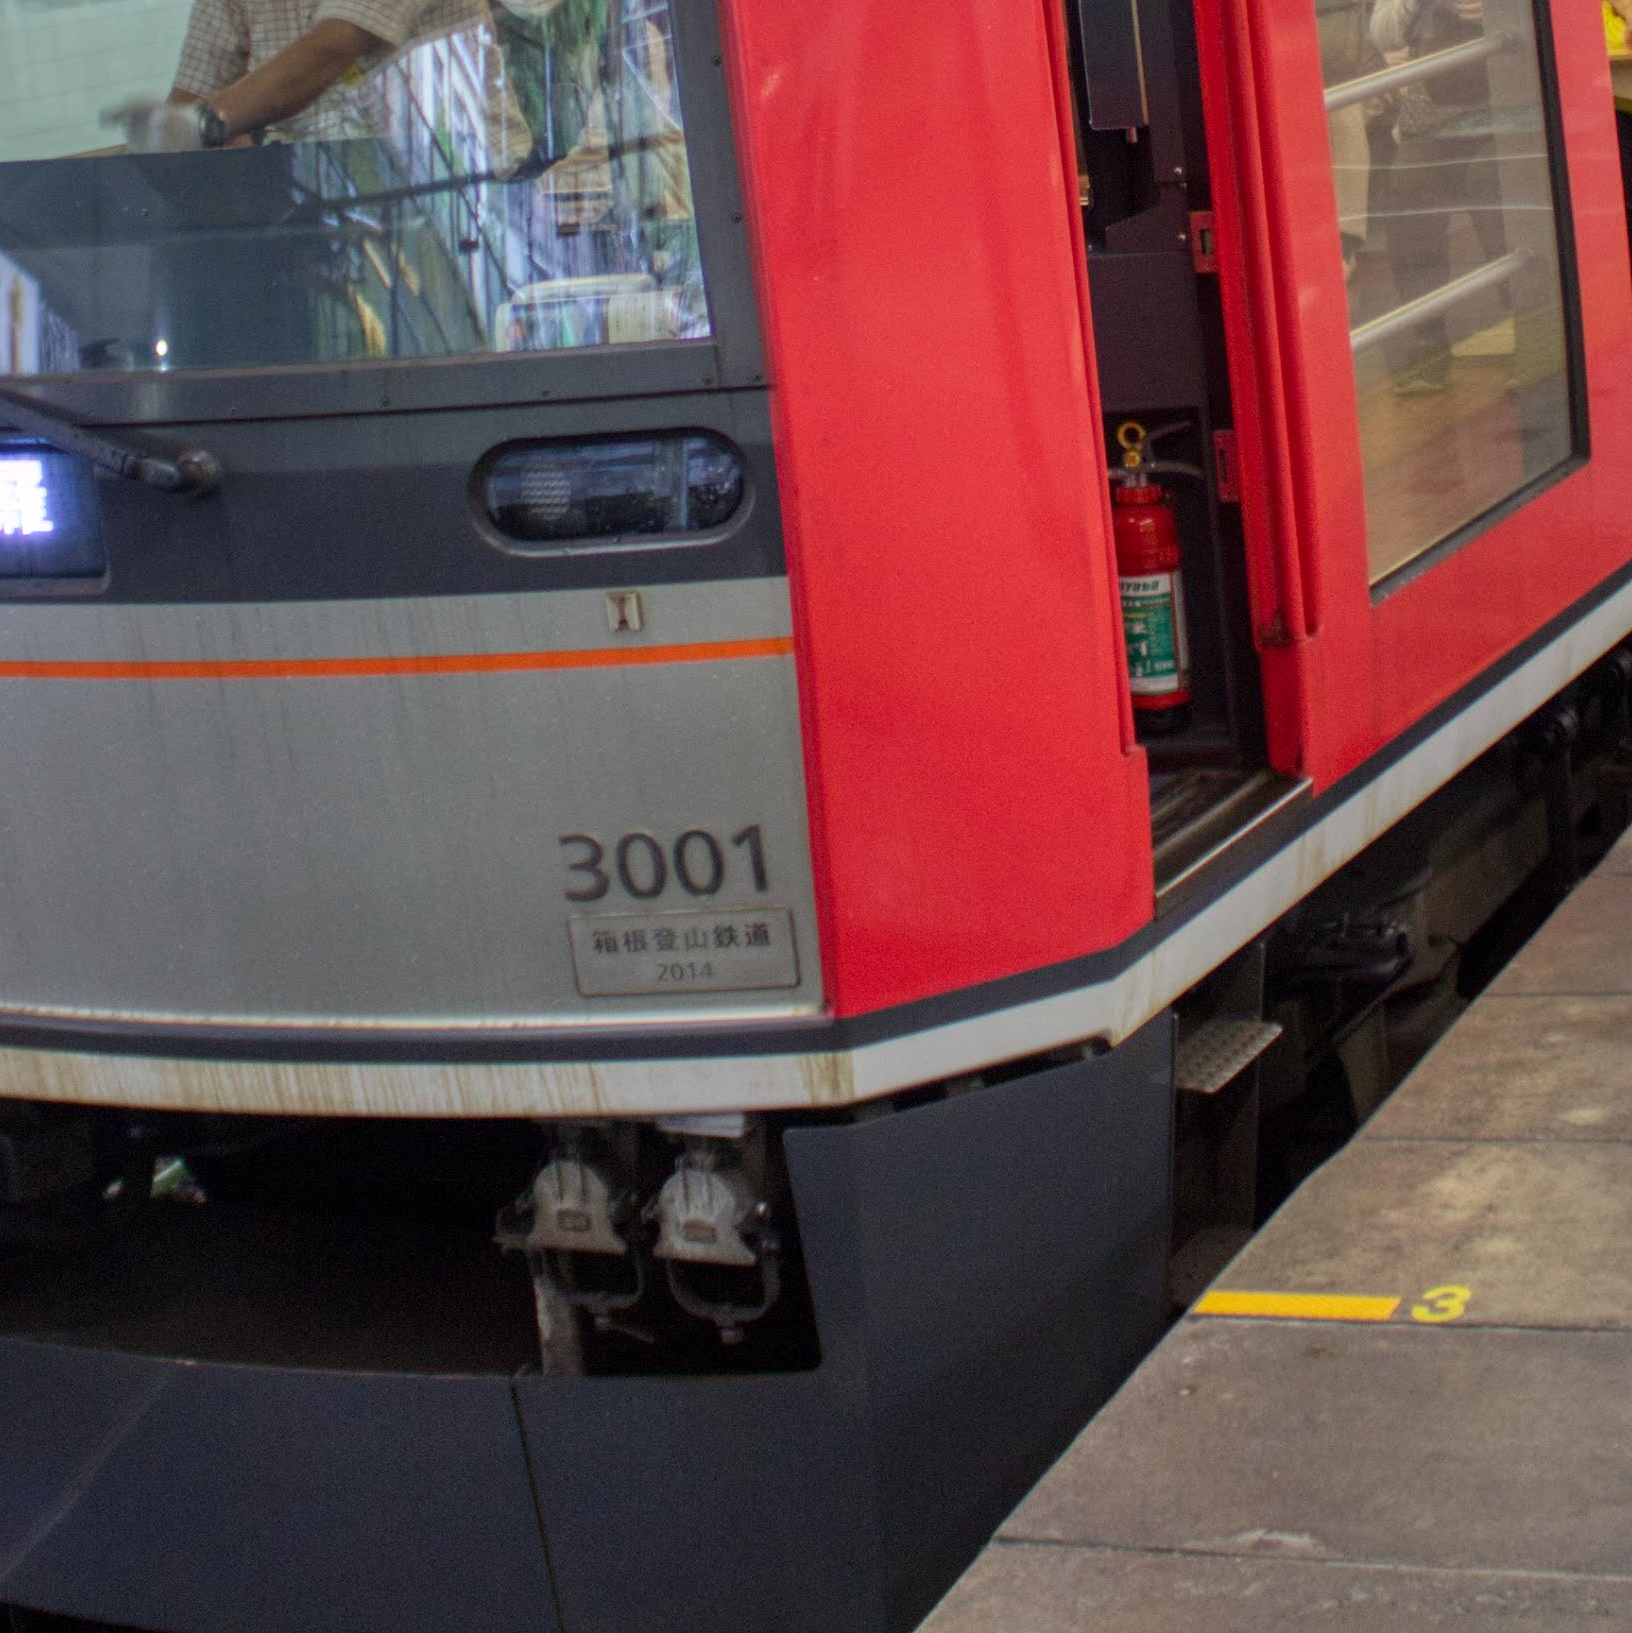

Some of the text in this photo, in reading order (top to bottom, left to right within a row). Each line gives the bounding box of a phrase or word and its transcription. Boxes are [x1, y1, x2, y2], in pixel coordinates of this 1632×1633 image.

[559, 824, 769, 902] 3001
[593, 922, 771, 954] 箱根登山鉄道
[656, 962, 713, 982] 2014
[1411, 1285, 1471, 1322] 3
